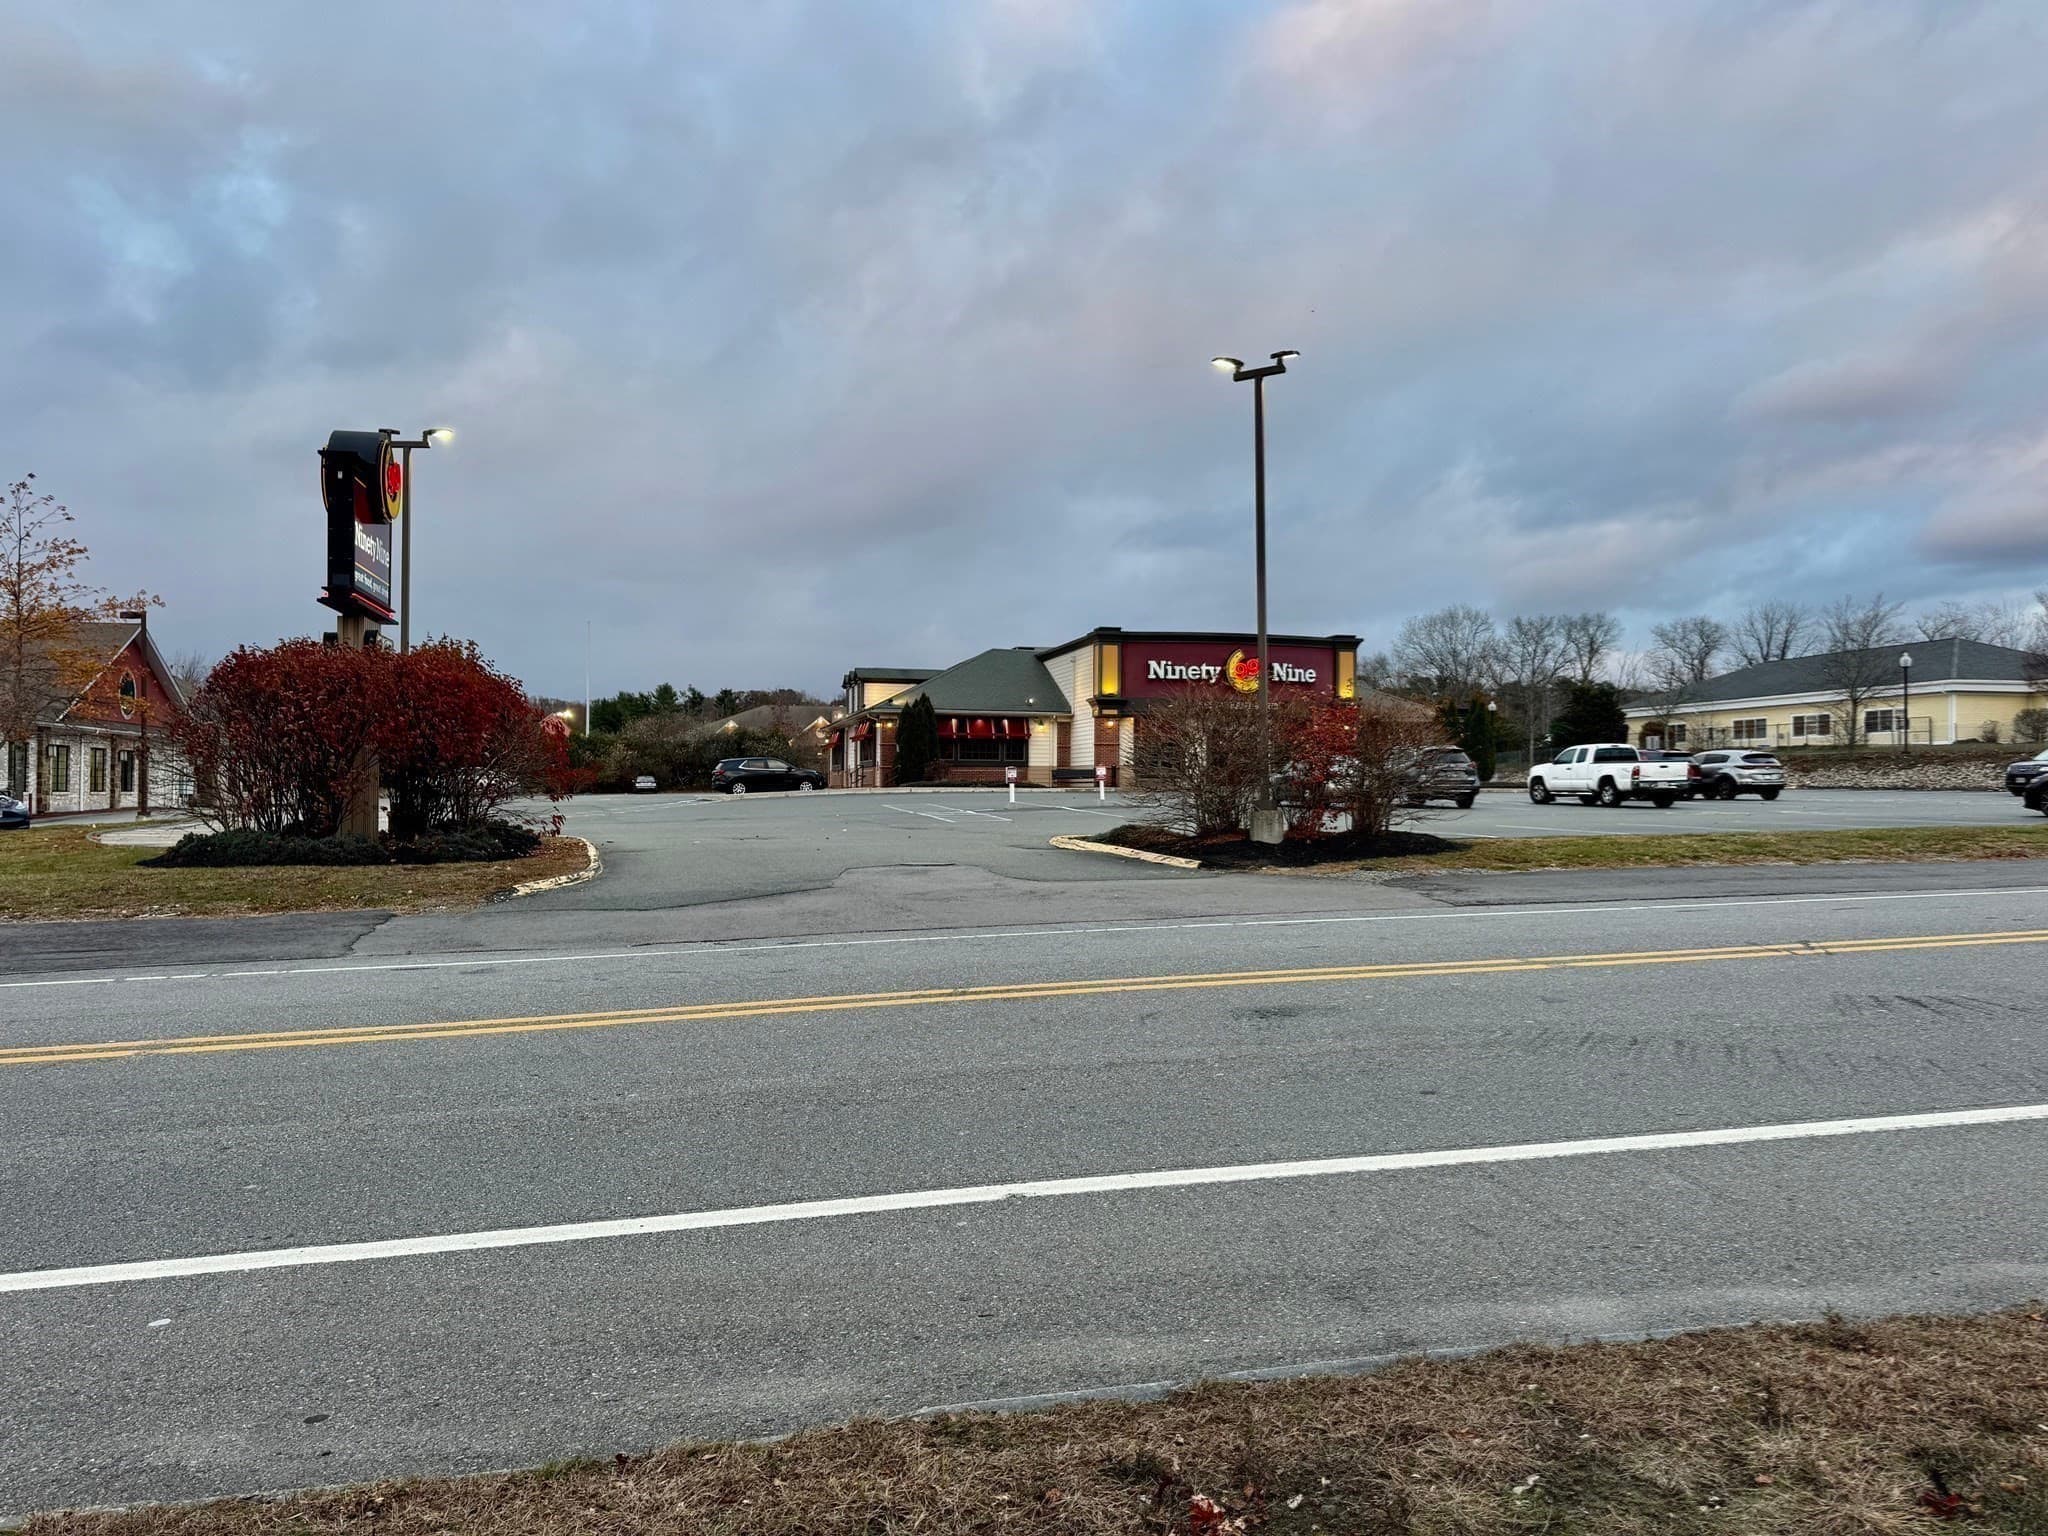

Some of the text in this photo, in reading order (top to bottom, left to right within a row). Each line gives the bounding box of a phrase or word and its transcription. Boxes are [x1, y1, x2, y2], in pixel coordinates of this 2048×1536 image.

[354, 519, 390, 568] Ninety Nine
[1147, 660, 1222, 683] Ninety
[1271, 662, 1317, 683] Nine
